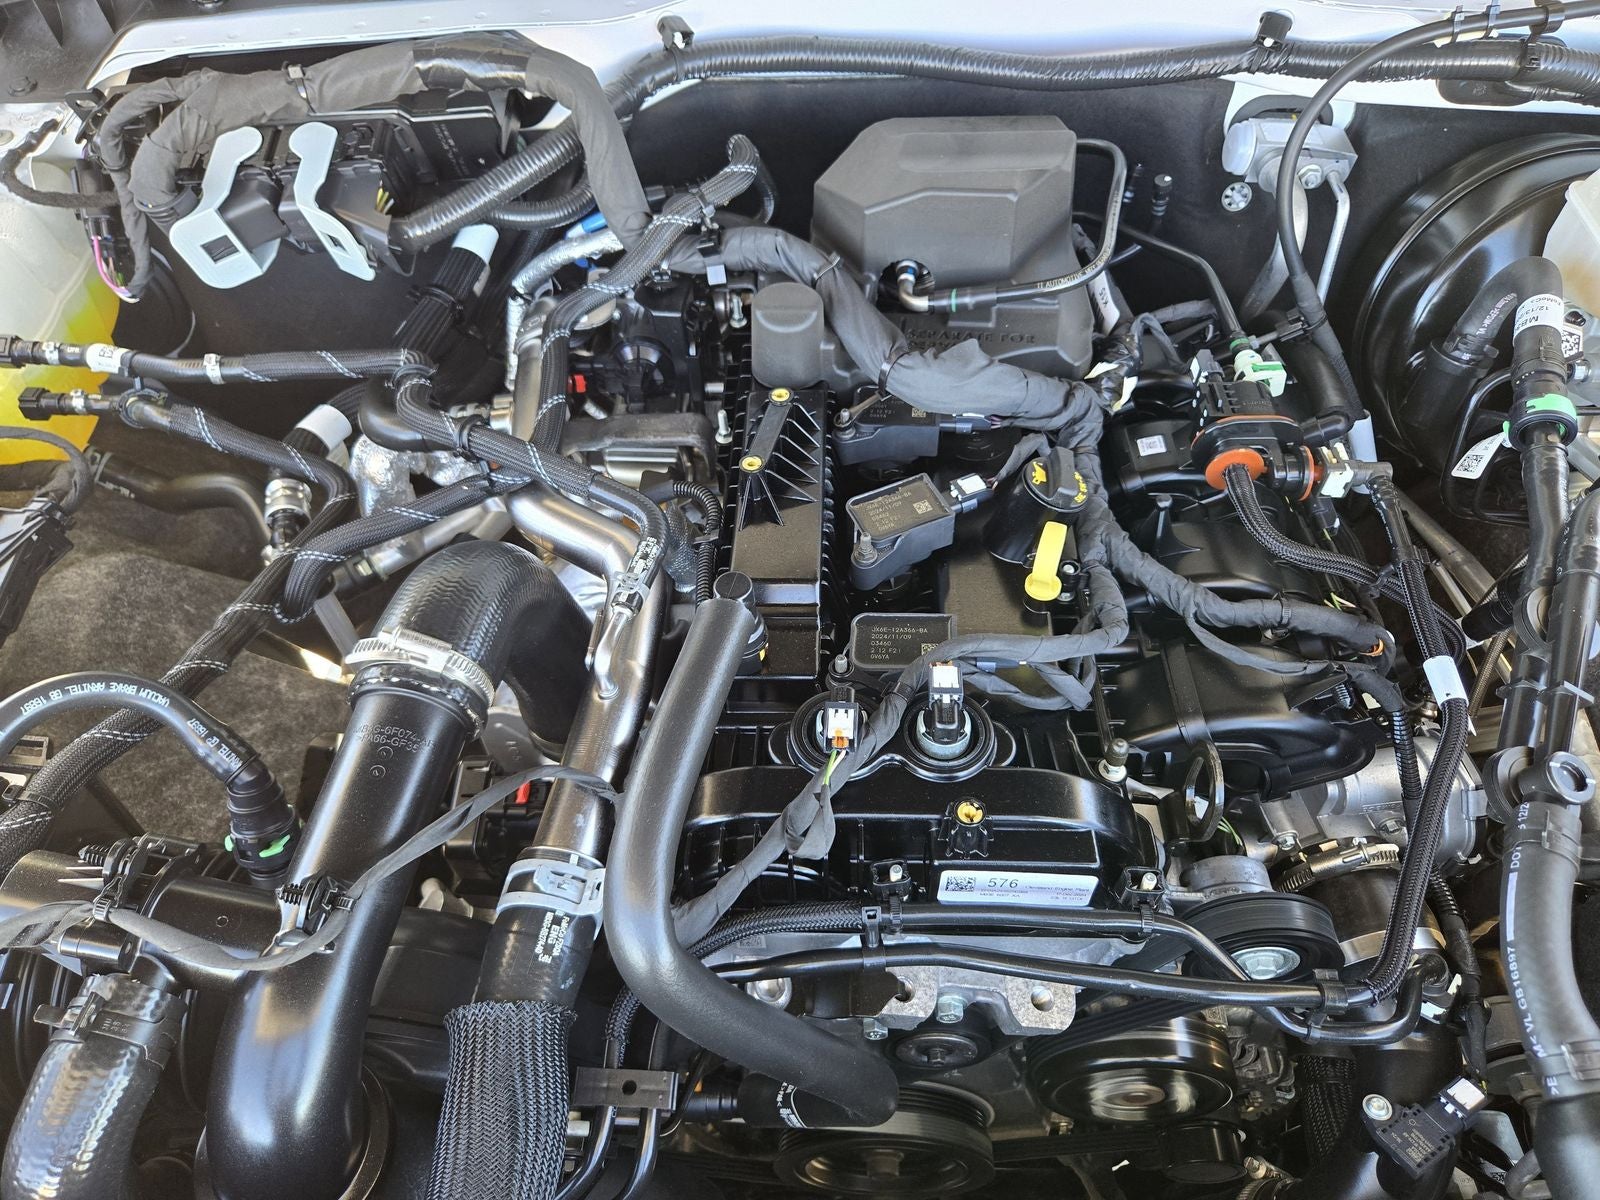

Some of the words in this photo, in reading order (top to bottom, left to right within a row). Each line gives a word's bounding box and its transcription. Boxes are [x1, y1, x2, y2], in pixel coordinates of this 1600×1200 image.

[871, 626, 928, 634] JX6E-12A366-BA
[871, 633, 912, 641] 2024/11/09
[49, 688, 63, 702] GB
[64, 681, 106, 696] ARNITEL
[109, 682, 138, 695] BRAKE
[138, 686, 170, 708] VACUUM
[20, 694, 47, 717] 16897
[987, 877, 1019, 889] 576
[548, 925, 560, 944] ENG
[1506, 946, 1528, 1010] GB16897
[1523, 1012, 1536, 1033] VL
